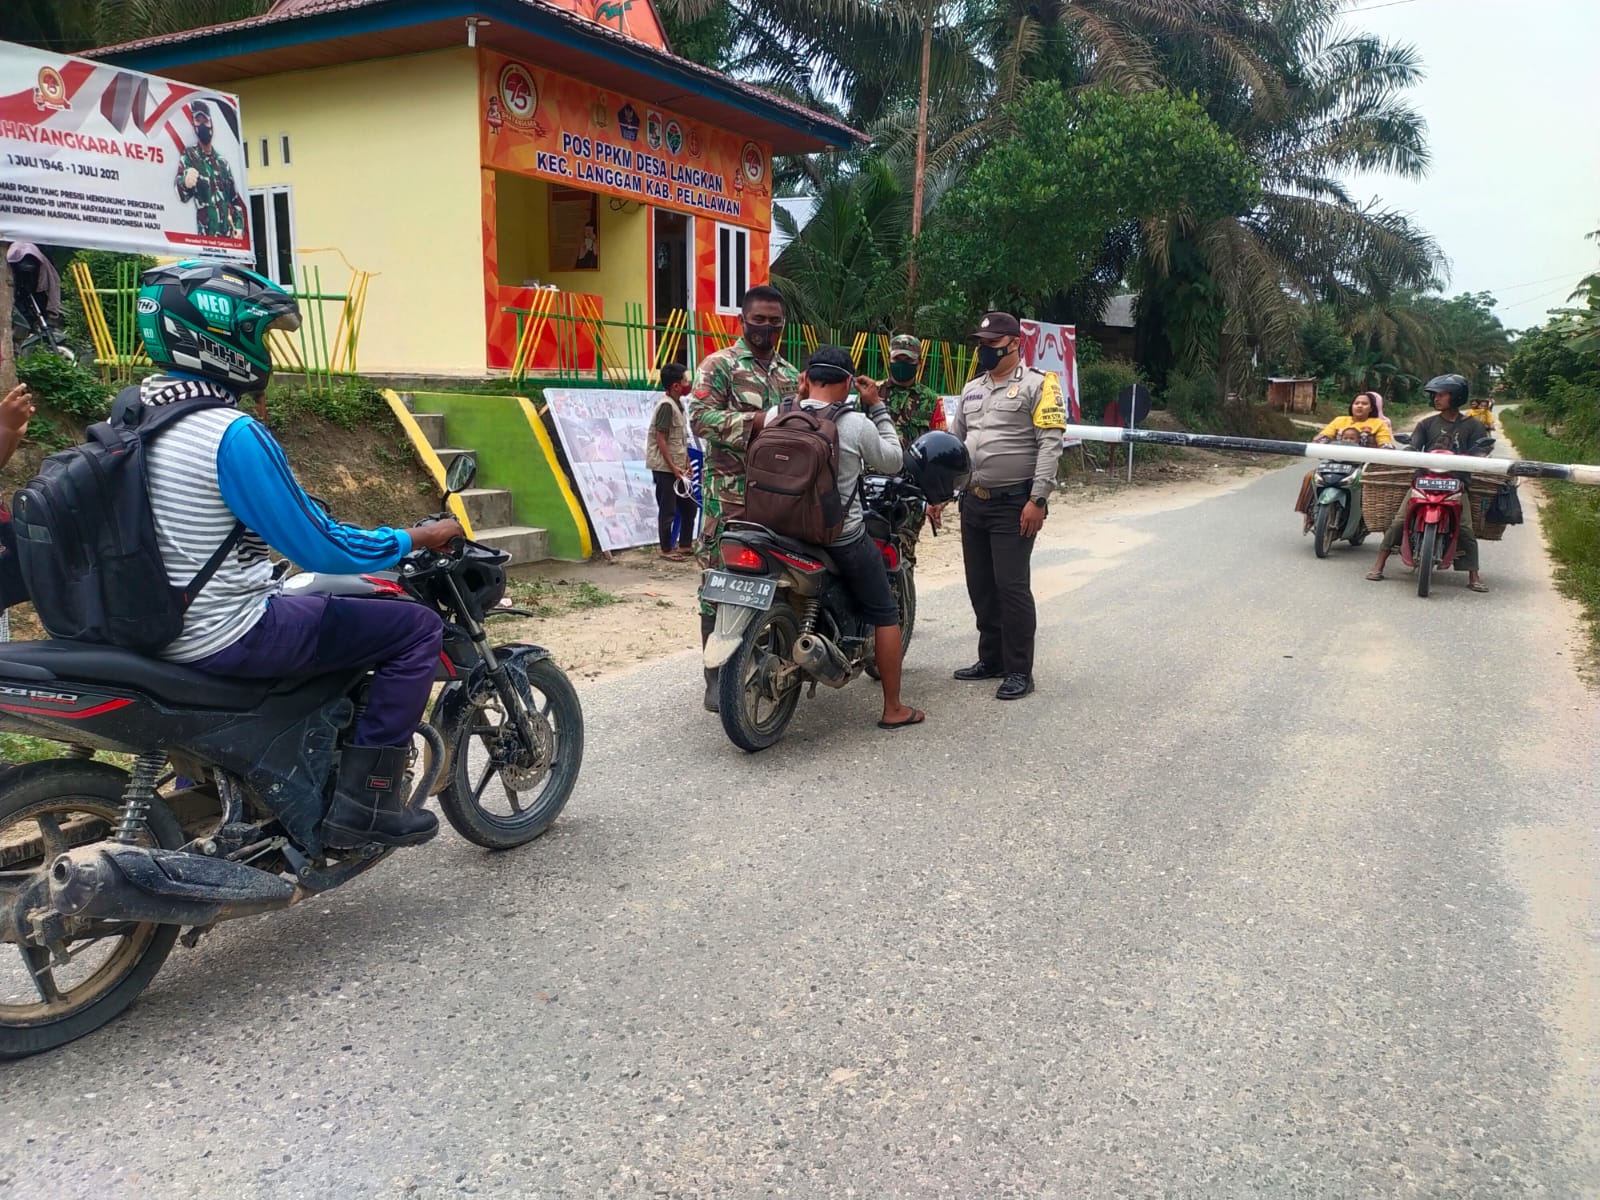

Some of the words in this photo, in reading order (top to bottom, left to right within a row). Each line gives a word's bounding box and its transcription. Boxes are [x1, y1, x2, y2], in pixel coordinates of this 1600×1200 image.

[124, 142, 164, 164] KE-75
[562, 133, 591, 158] POS
[595, 142, 632, 168] PPKM
[636, 152, 667, 178] DESA
[670, 163, 723, 193] LANGKAN
[7, 154, 14, 165] 1
[15, 155, 38, 168] JULI
[39, 158, 64, 172] 1946
[71, 163, 77, 174] 1
[78, 164, 98, 177] JULI
[100, 167, 120, 180] 2021
[537, 152, 572, 176] KEC.
[577, 161, 643, 193] LANGGAM
[646, 178, 673, 200] KAB.
[676, 187, 740, 216] PELALAWAN
[17, 184, 39, 194] POLRI
[40, 187, 59, 197] YANG
[60, 190, 84, 200] PRESISI
[86, 194, 126, 206] MENDUKUNG
[127, 199, 165, 211] PERCEPATAN
[24, 196, 55, 207] COVID-19
[57, 200, 79, 209] UNTUK
[81, 204, 122, 215] MASYARAKAT
[124, 209, 143, 218] SEHAT
[144, 211, 157, 219] DAN
[13, 206, 46, 217] EKONOMI
[47, 210, 81, 221] NASIONAL
[82, 214, 109, 224] MENUJU
[110, 217, 143, 228] INDONESIA
[145, 222, 161, 230] MAJU
[196, 292, 231, 316] NEO
[710, 575, 727, 588] BM
[729, 579, 755, 593] 4212
[757, 583, 771, 596] IR
